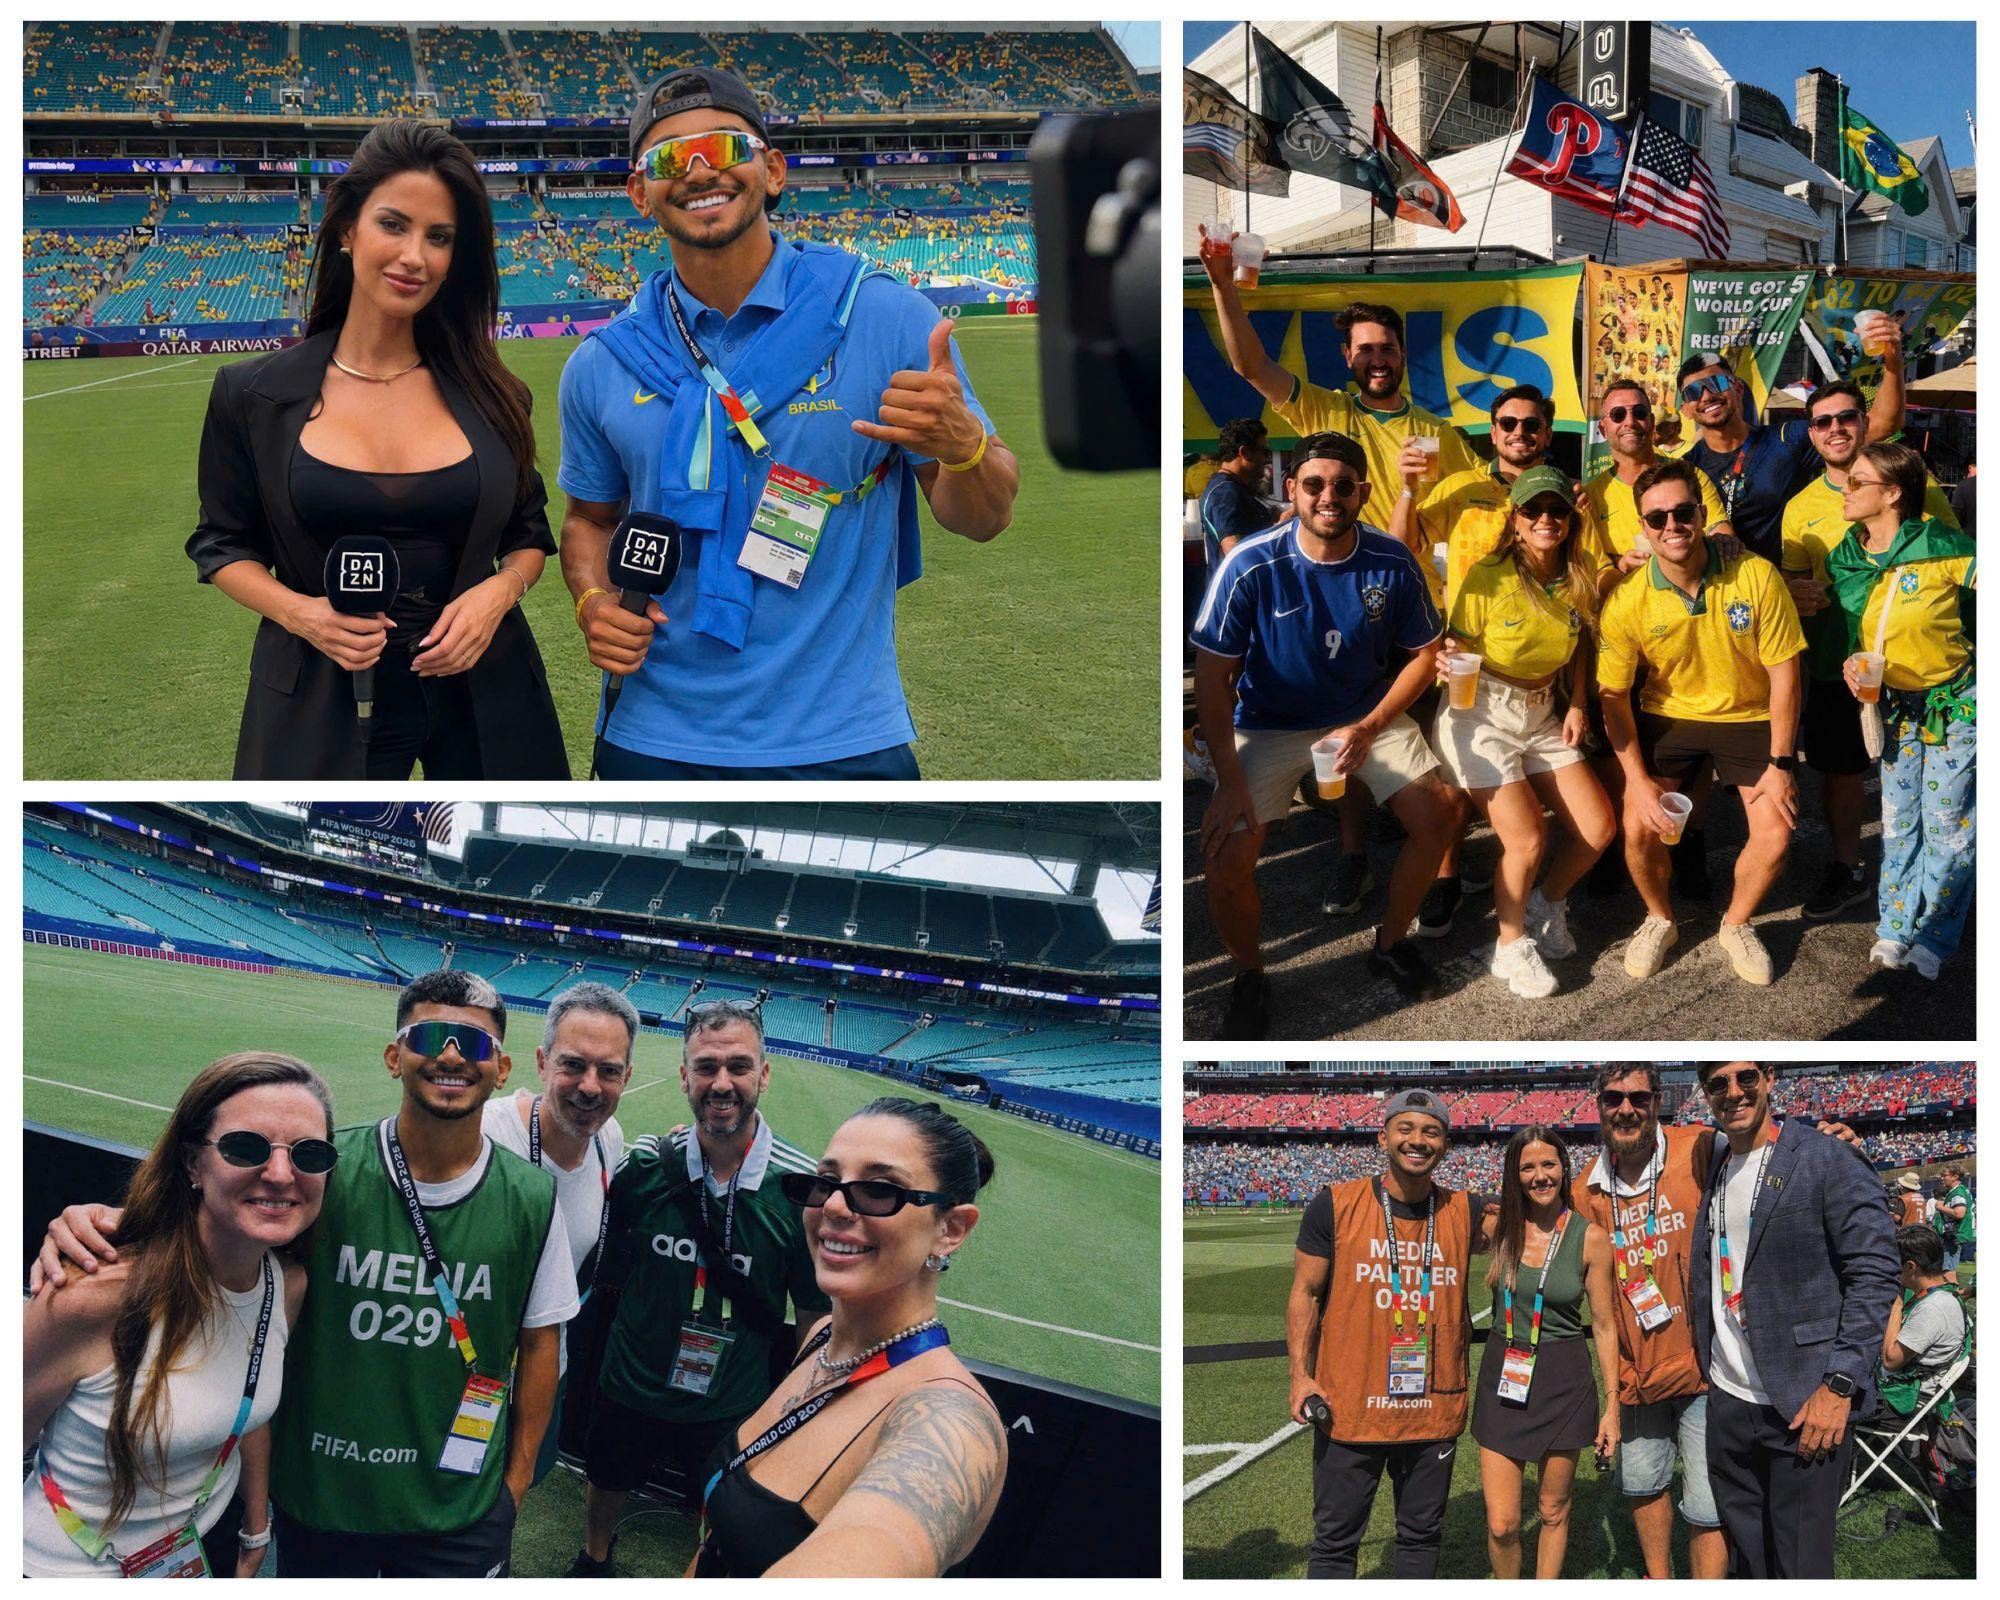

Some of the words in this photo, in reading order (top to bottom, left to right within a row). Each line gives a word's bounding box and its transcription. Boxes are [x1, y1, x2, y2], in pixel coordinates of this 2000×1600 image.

[1692, 279, 1744, 295] WE'VE
[1749, 280, 1787, 295] GOT
[1789, 274, 1809, 294] 5
[1823, 278, 1855, 310] 62
[1863, 281, 1898, 307] 70
[1694, 298, 1754, 314] WORLD
[1760, 297, 1793, 312] CUP
[143, 340, 202, 357] QATAR
[209, 338, 283, 352] AIRWAYS
[1691, 333, 1755, 349] RESPECT
[1757, 331, 1784, 346] US!
[788, 399, 843, 415] BRASIL
[1324, 629, 1342, 660] 9
[320, 818, 339, 830] FIFA
[340, 823, 371, 837] WORLD
[372, 831, 390, 841] CUP
[390, 835, 416, 848] 2026
[980, 983, 997, 992] FIFA
[998, 986, 1026, 996] WORLD
[1027, 990, 1045, 998] CUP
[1907, 1106, 1926, 1115] FRANCE
[401, 1178, 414, 1199] CUP
[409, 1199, 427, 1237] WORLD
[1619, 1194, 1672, 1226] MEDA
[421, 1236, 436, 1260] FIFA
[1370, 1239, 1444, 1262] MEDIA
[336, 1244, 493, 1301] MEDIA
[261, 1284, 273, 1321] WORLD
[1376, 1288, 1435, 1311] 0291
[257, 1322, 267, 1344] CUP
[1367, 1396, 1432, 1409] FIFA.com
[311, 1432, 418, 1464] FIFA.com
[730, 1453, 746, 1471] FIFA
[746, 1430, 778, 1457] WORLD
[778, 1416, 798, 1434] CUP
